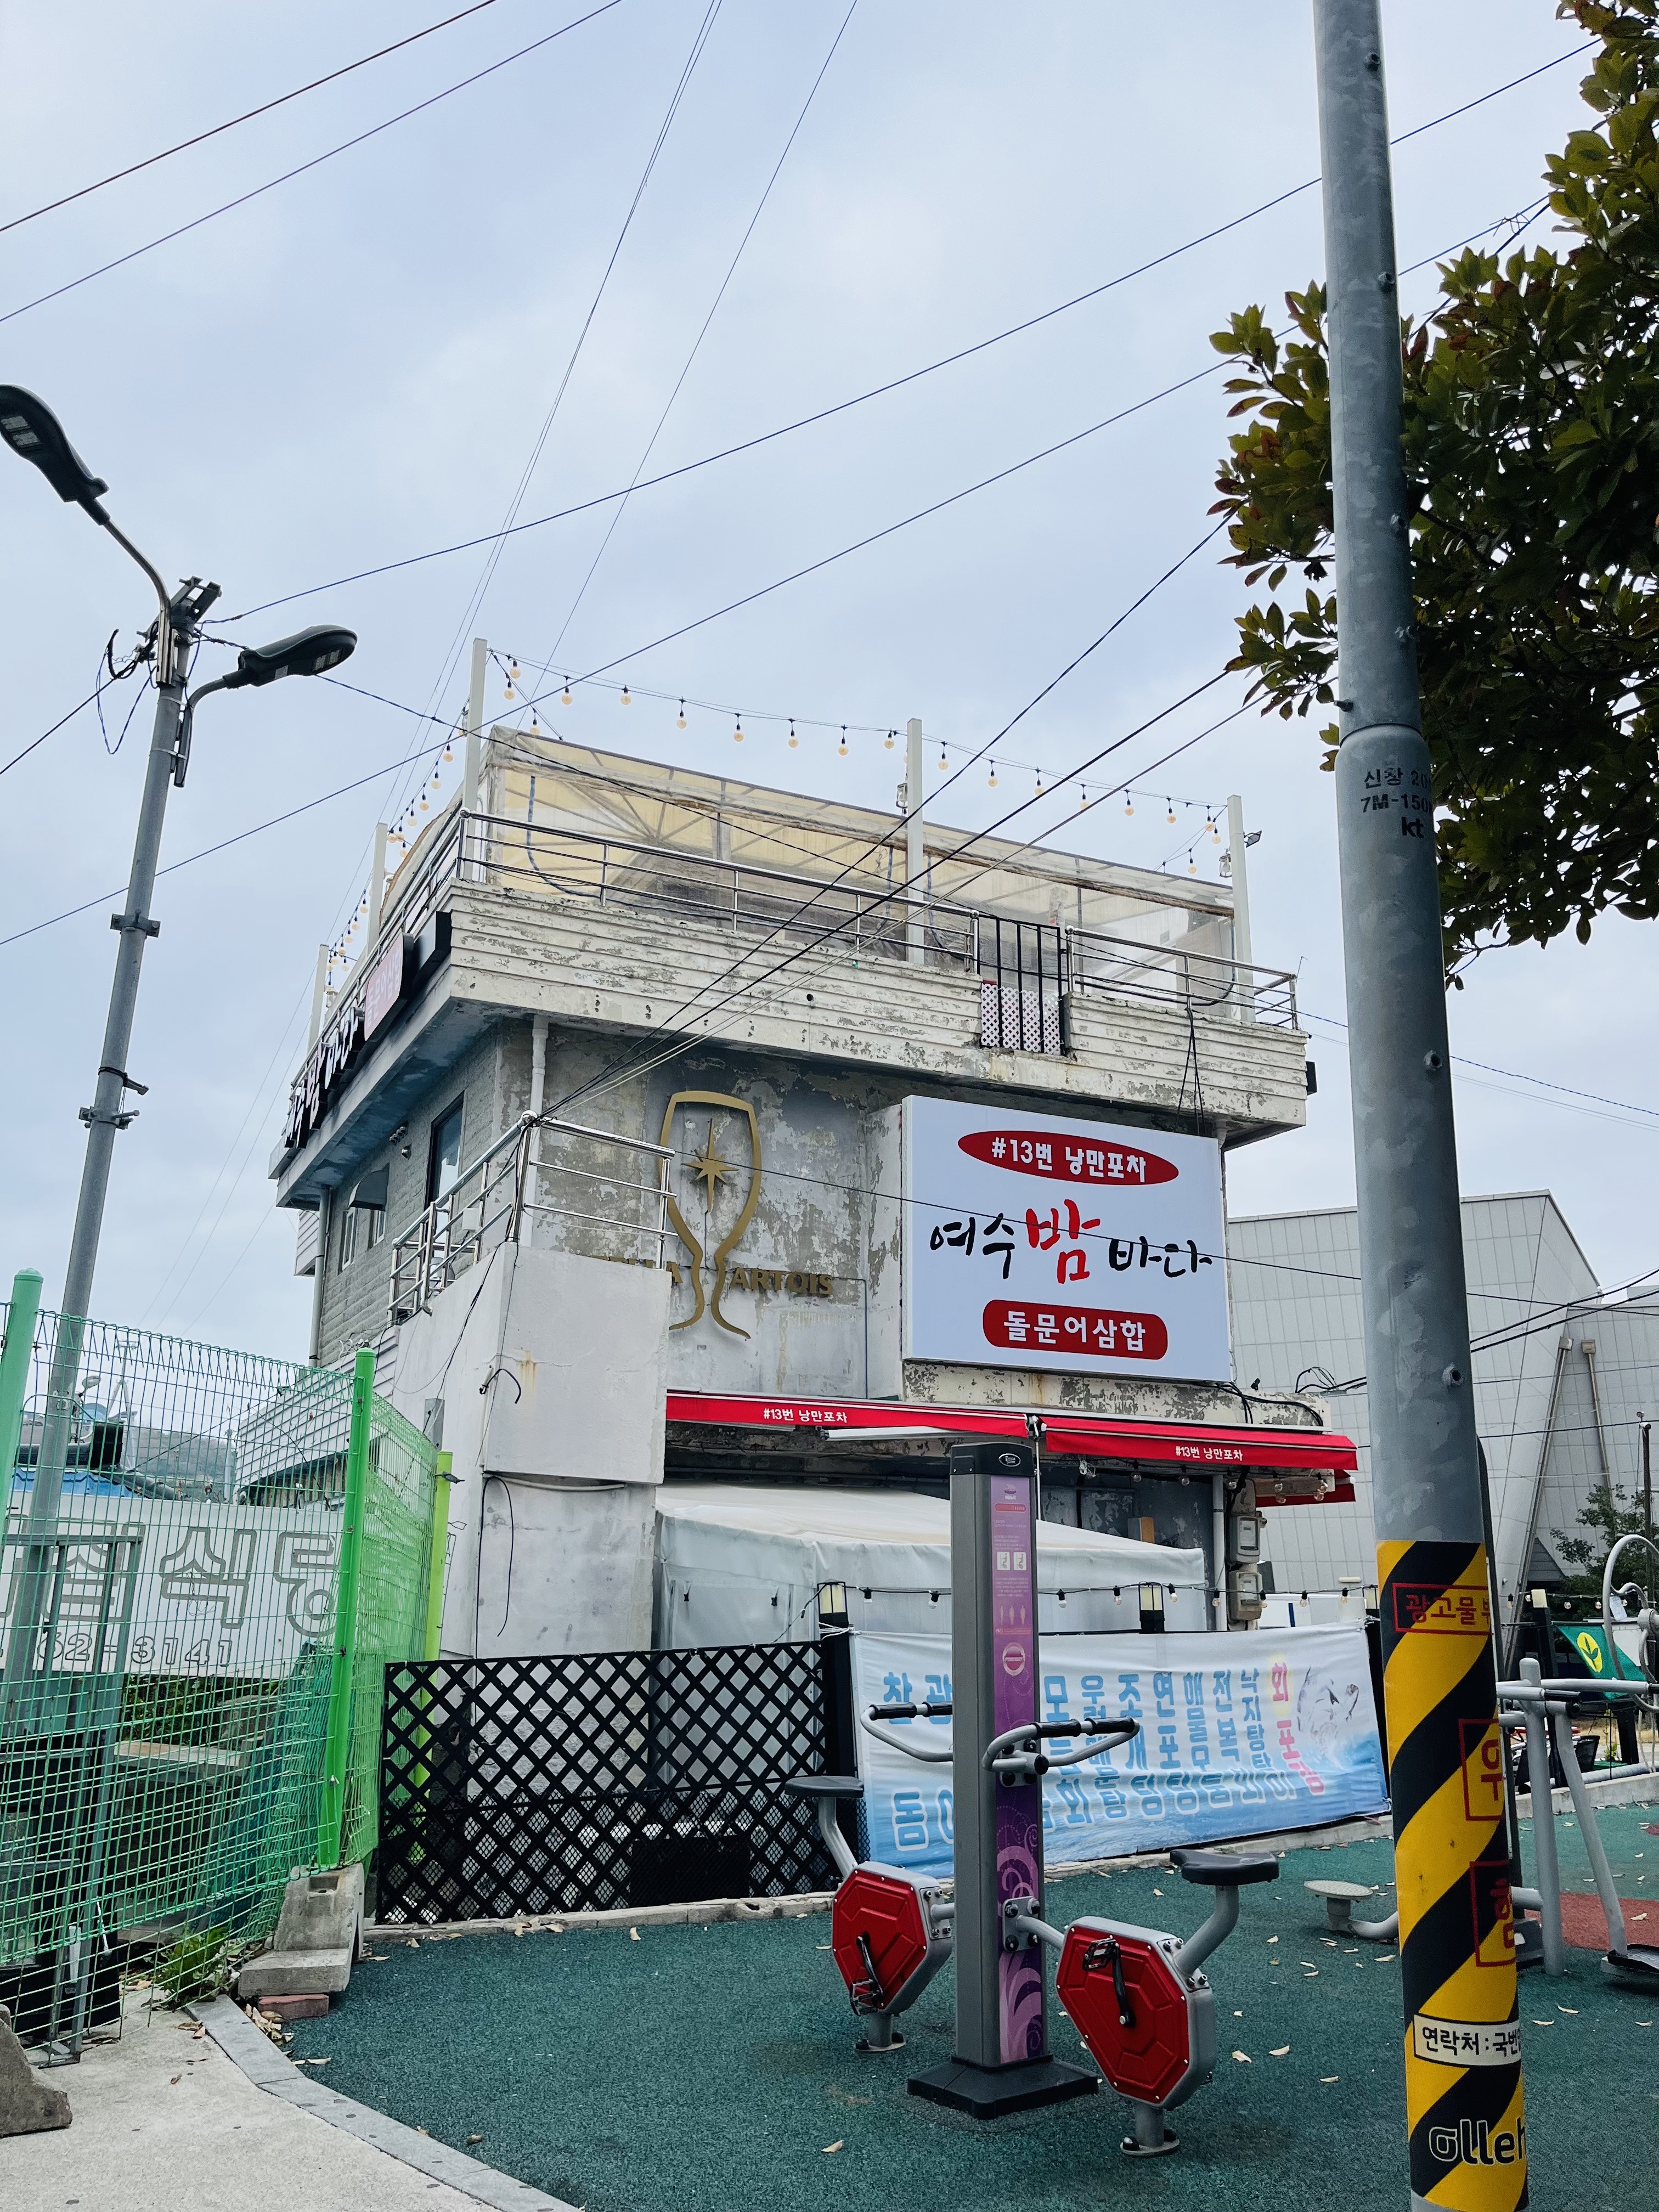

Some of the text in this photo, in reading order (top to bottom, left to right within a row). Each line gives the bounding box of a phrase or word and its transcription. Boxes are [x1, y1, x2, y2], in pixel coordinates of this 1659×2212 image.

[1401, 816, 1425, 839] kt
[991, 1137, 1146, 1183] #13번 낭만포차
[730, 1267, 833, 1295] ARTOIS
[1003, 1310, 1146, 1351] 돌문어삼합
[763, 1408, 848, 1424] #13번 낭만포차
[1175, 1446, 1243, 1462] #13번 낭만포차
[1406, 1594, 1477, 1626] 광고물
